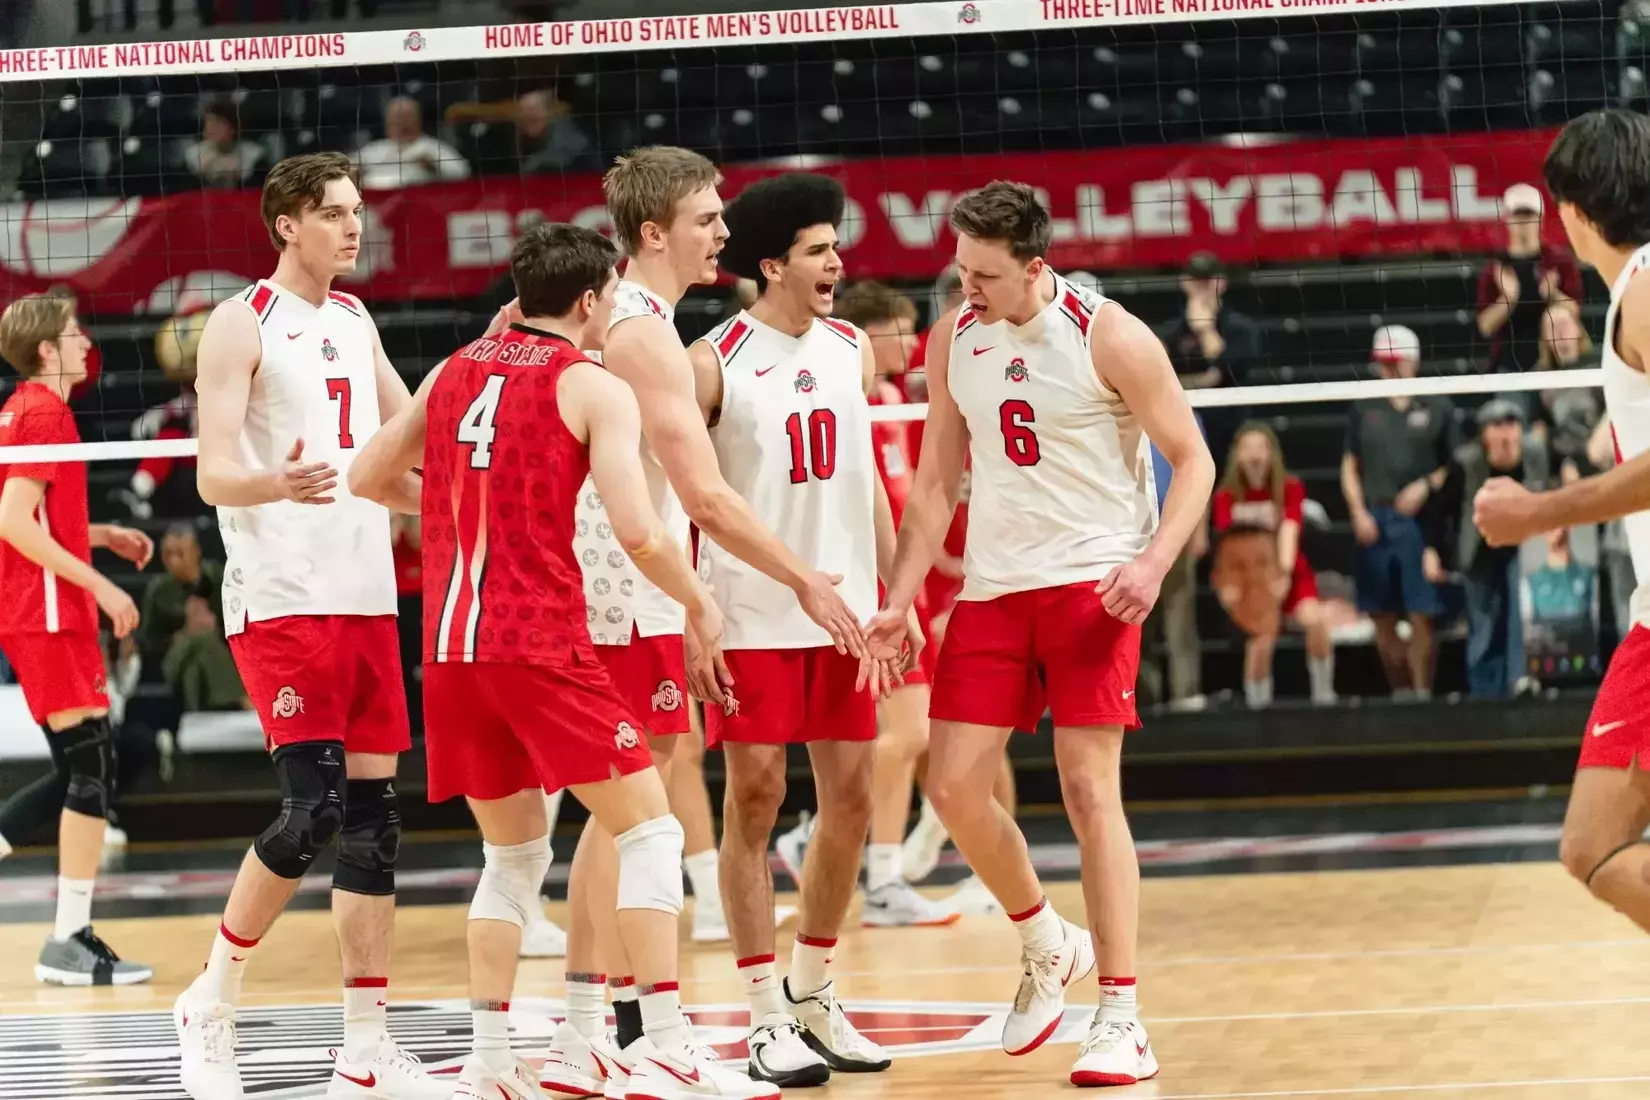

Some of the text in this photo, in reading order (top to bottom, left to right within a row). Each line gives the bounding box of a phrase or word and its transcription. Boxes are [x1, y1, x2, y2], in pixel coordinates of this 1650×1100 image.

[485, 8, 899, 49] HOME OF OHIO STATE MEN'S VOLLEYBALL
[1040, 0, 1164, 19] THREE-TIME
[115, 41, 215, 66] NATIONAL
[221, 34, 345, 62] CHAMPIONS
[877, 163, 1504, 248] VLEYBALL
[497, 341, 559, 366] STATE
[325, 377, 354, 449] 7
[456, 373, 508, 470] 4
[785, 408, 837, 485] 10
[999, 399, 1042, 467] 6
